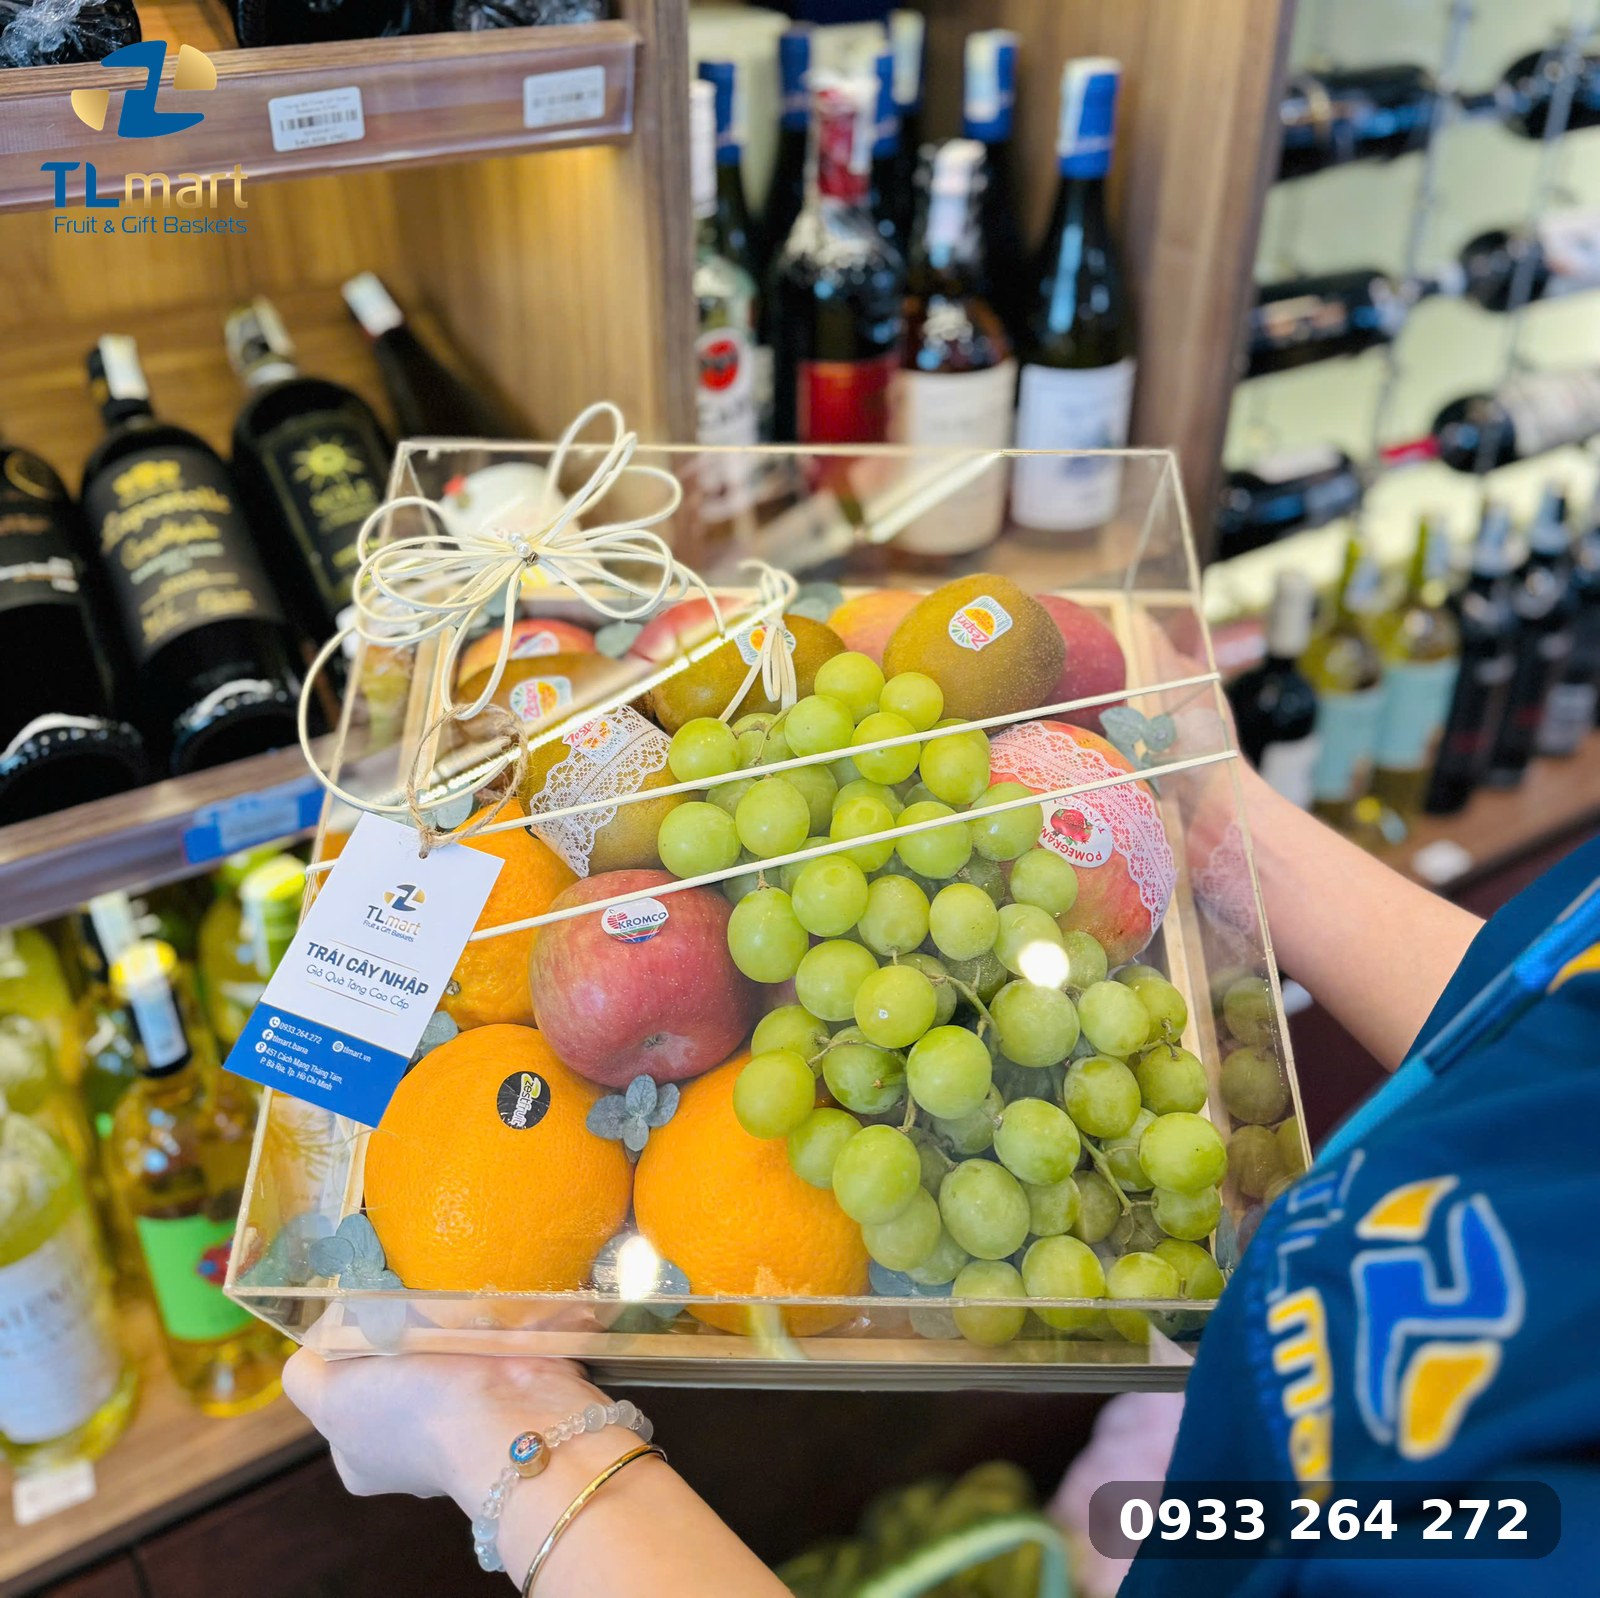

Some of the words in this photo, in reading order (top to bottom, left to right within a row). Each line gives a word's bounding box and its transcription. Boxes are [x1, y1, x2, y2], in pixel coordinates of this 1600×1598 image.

[953, 615, 990, 649] Zespri
[564, 719, 598, 745] Zesp
[1041, 825, 1103, 863] POMEGRAN
[366, 905, 421, 936] TLmart
[618, 911, 668, 930] KROMCO
[306, 941, 346, 967] TRÁI
[345, 957, 381, 979] CÂY
[379, 969, 430, 996] NHẬP
[325, 971, 345, 986] Quà
[369, 987, 388, 1002] Cao
[390, 994, 410, 1011] Cấp
[279, 1022, 323, 1044] 0933.264.272
[343, 1046, 372, 1062] tlmart.vn
